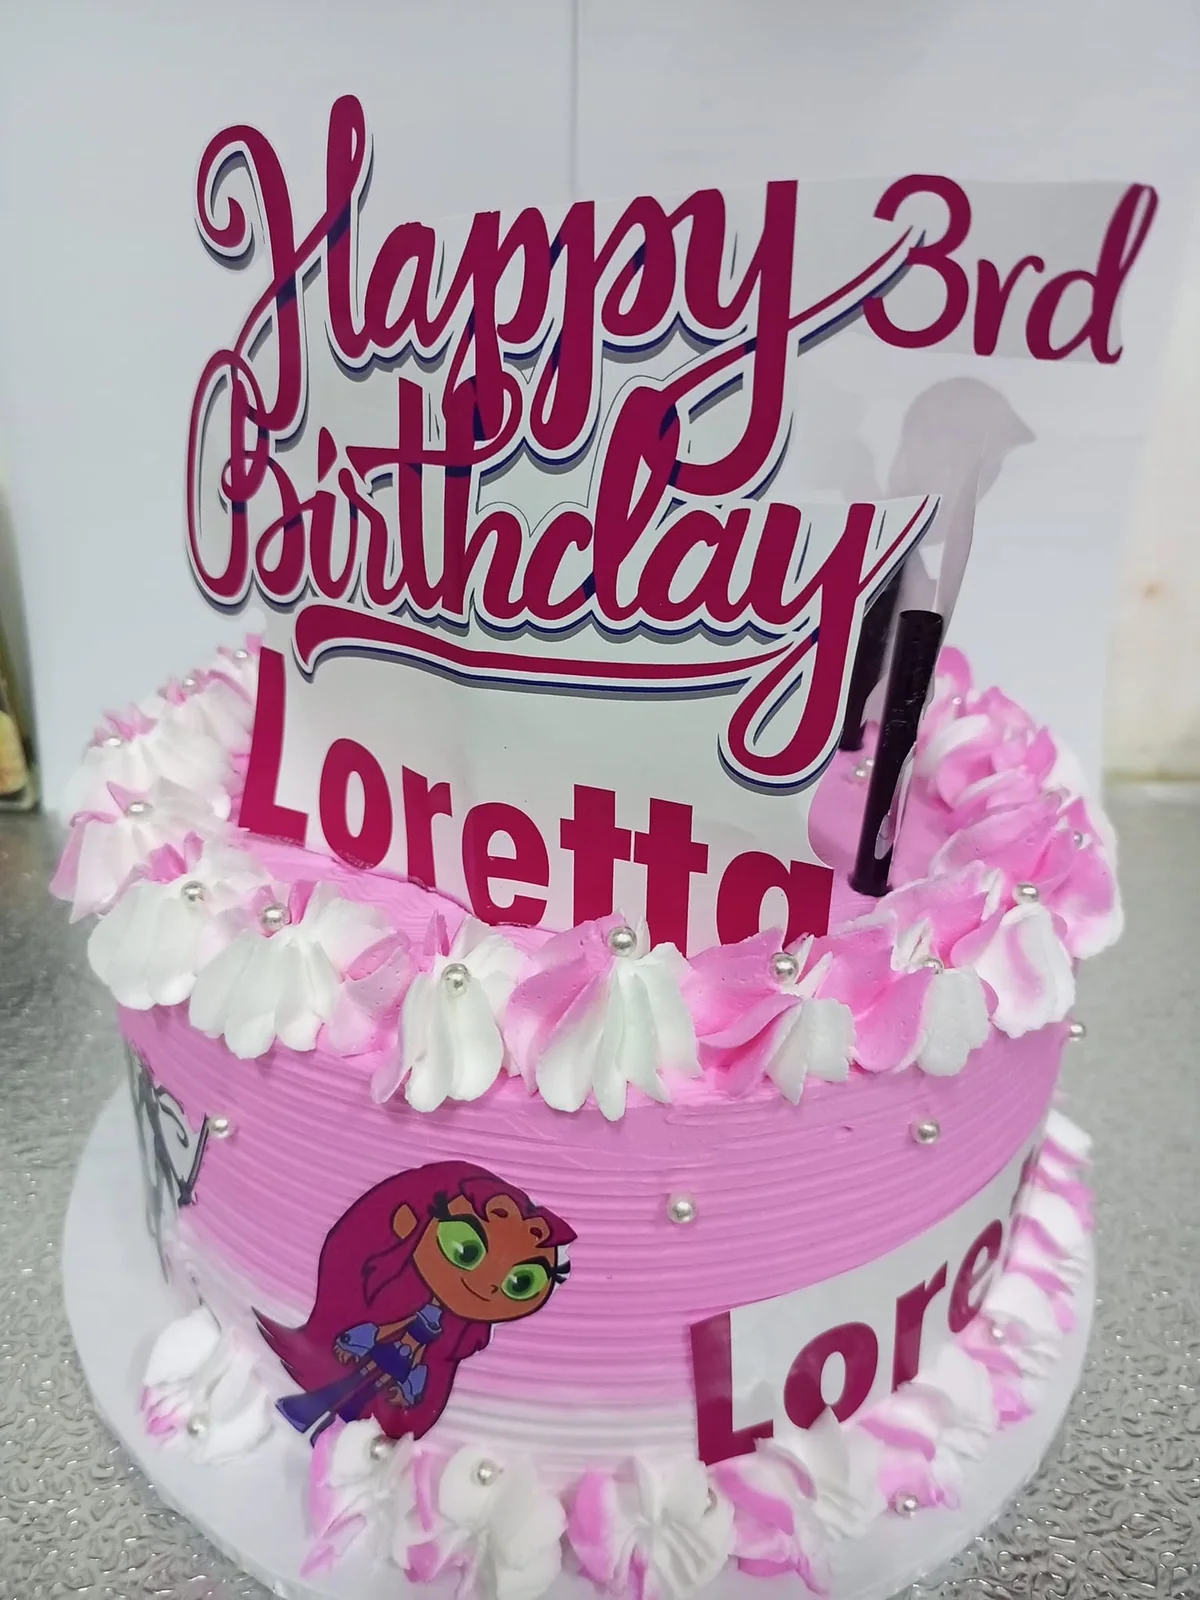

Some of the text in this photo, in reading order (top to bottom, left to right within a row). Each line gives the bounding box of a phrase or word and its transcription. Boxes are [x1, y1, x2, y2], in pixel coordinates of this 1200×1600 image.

[196, 93, 1159, 496] Happy 3rd
[187, 348, 932, 776] Birthday
[238, 646, 835, 958] Loretta
[690, 1146, 1037, 1466] Lore
